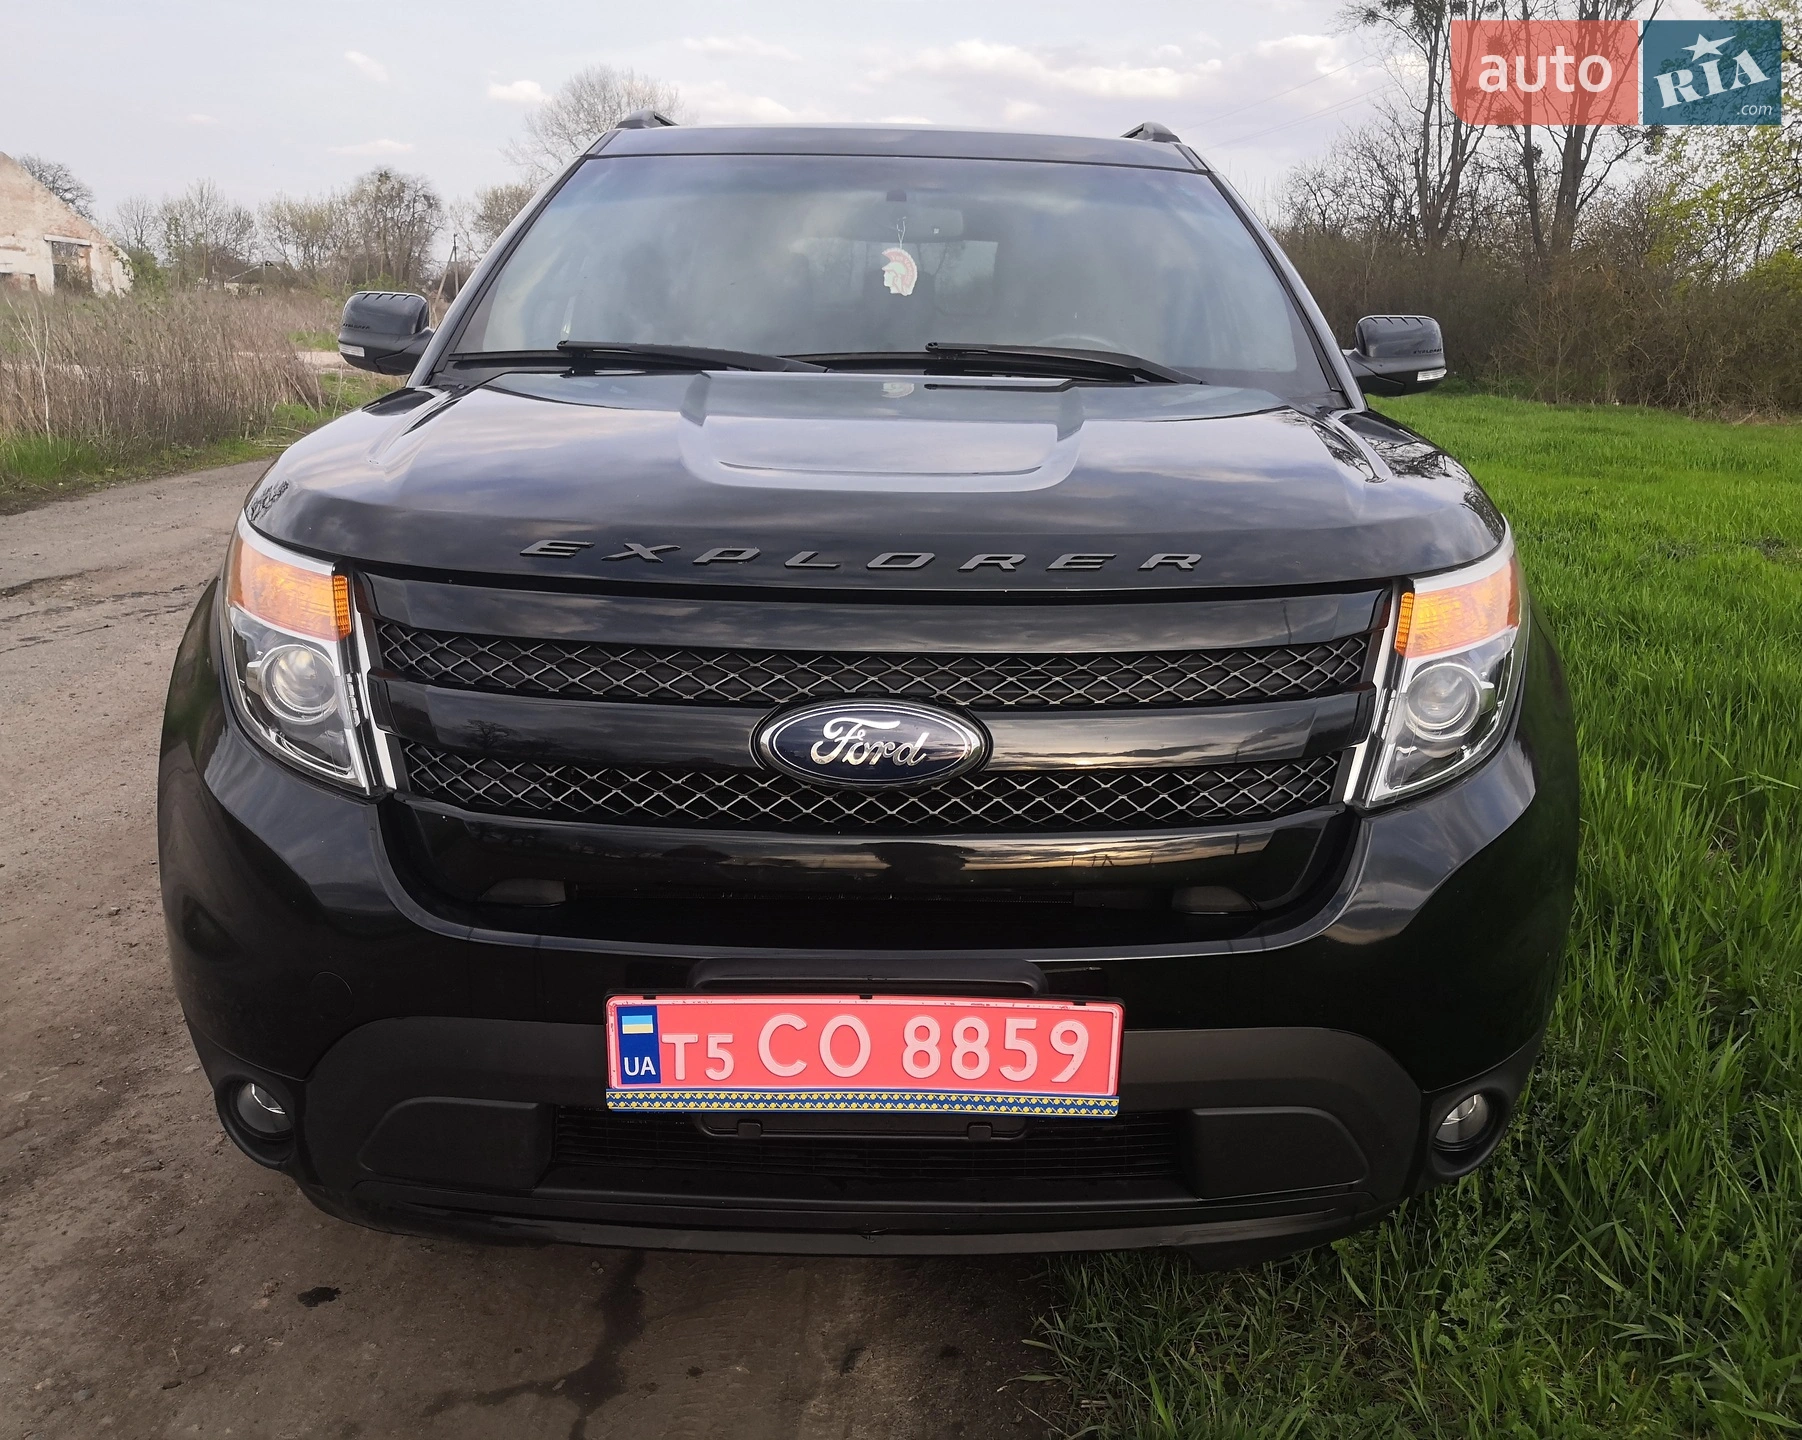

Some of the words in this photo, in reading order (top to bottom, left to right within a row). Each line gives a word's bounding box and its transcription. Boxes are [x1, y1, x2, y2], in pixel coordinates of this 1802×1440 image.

[520, 539, 1202, 573] EXPLORER
[810, 716, 927, 767] Ford
[624, 1056, 656, 1077] UA
[661, 1034, 734, 1081] T5
[757, 1013, 871, 1078] CO
[902, 1015, 1089, 1083] 8859
